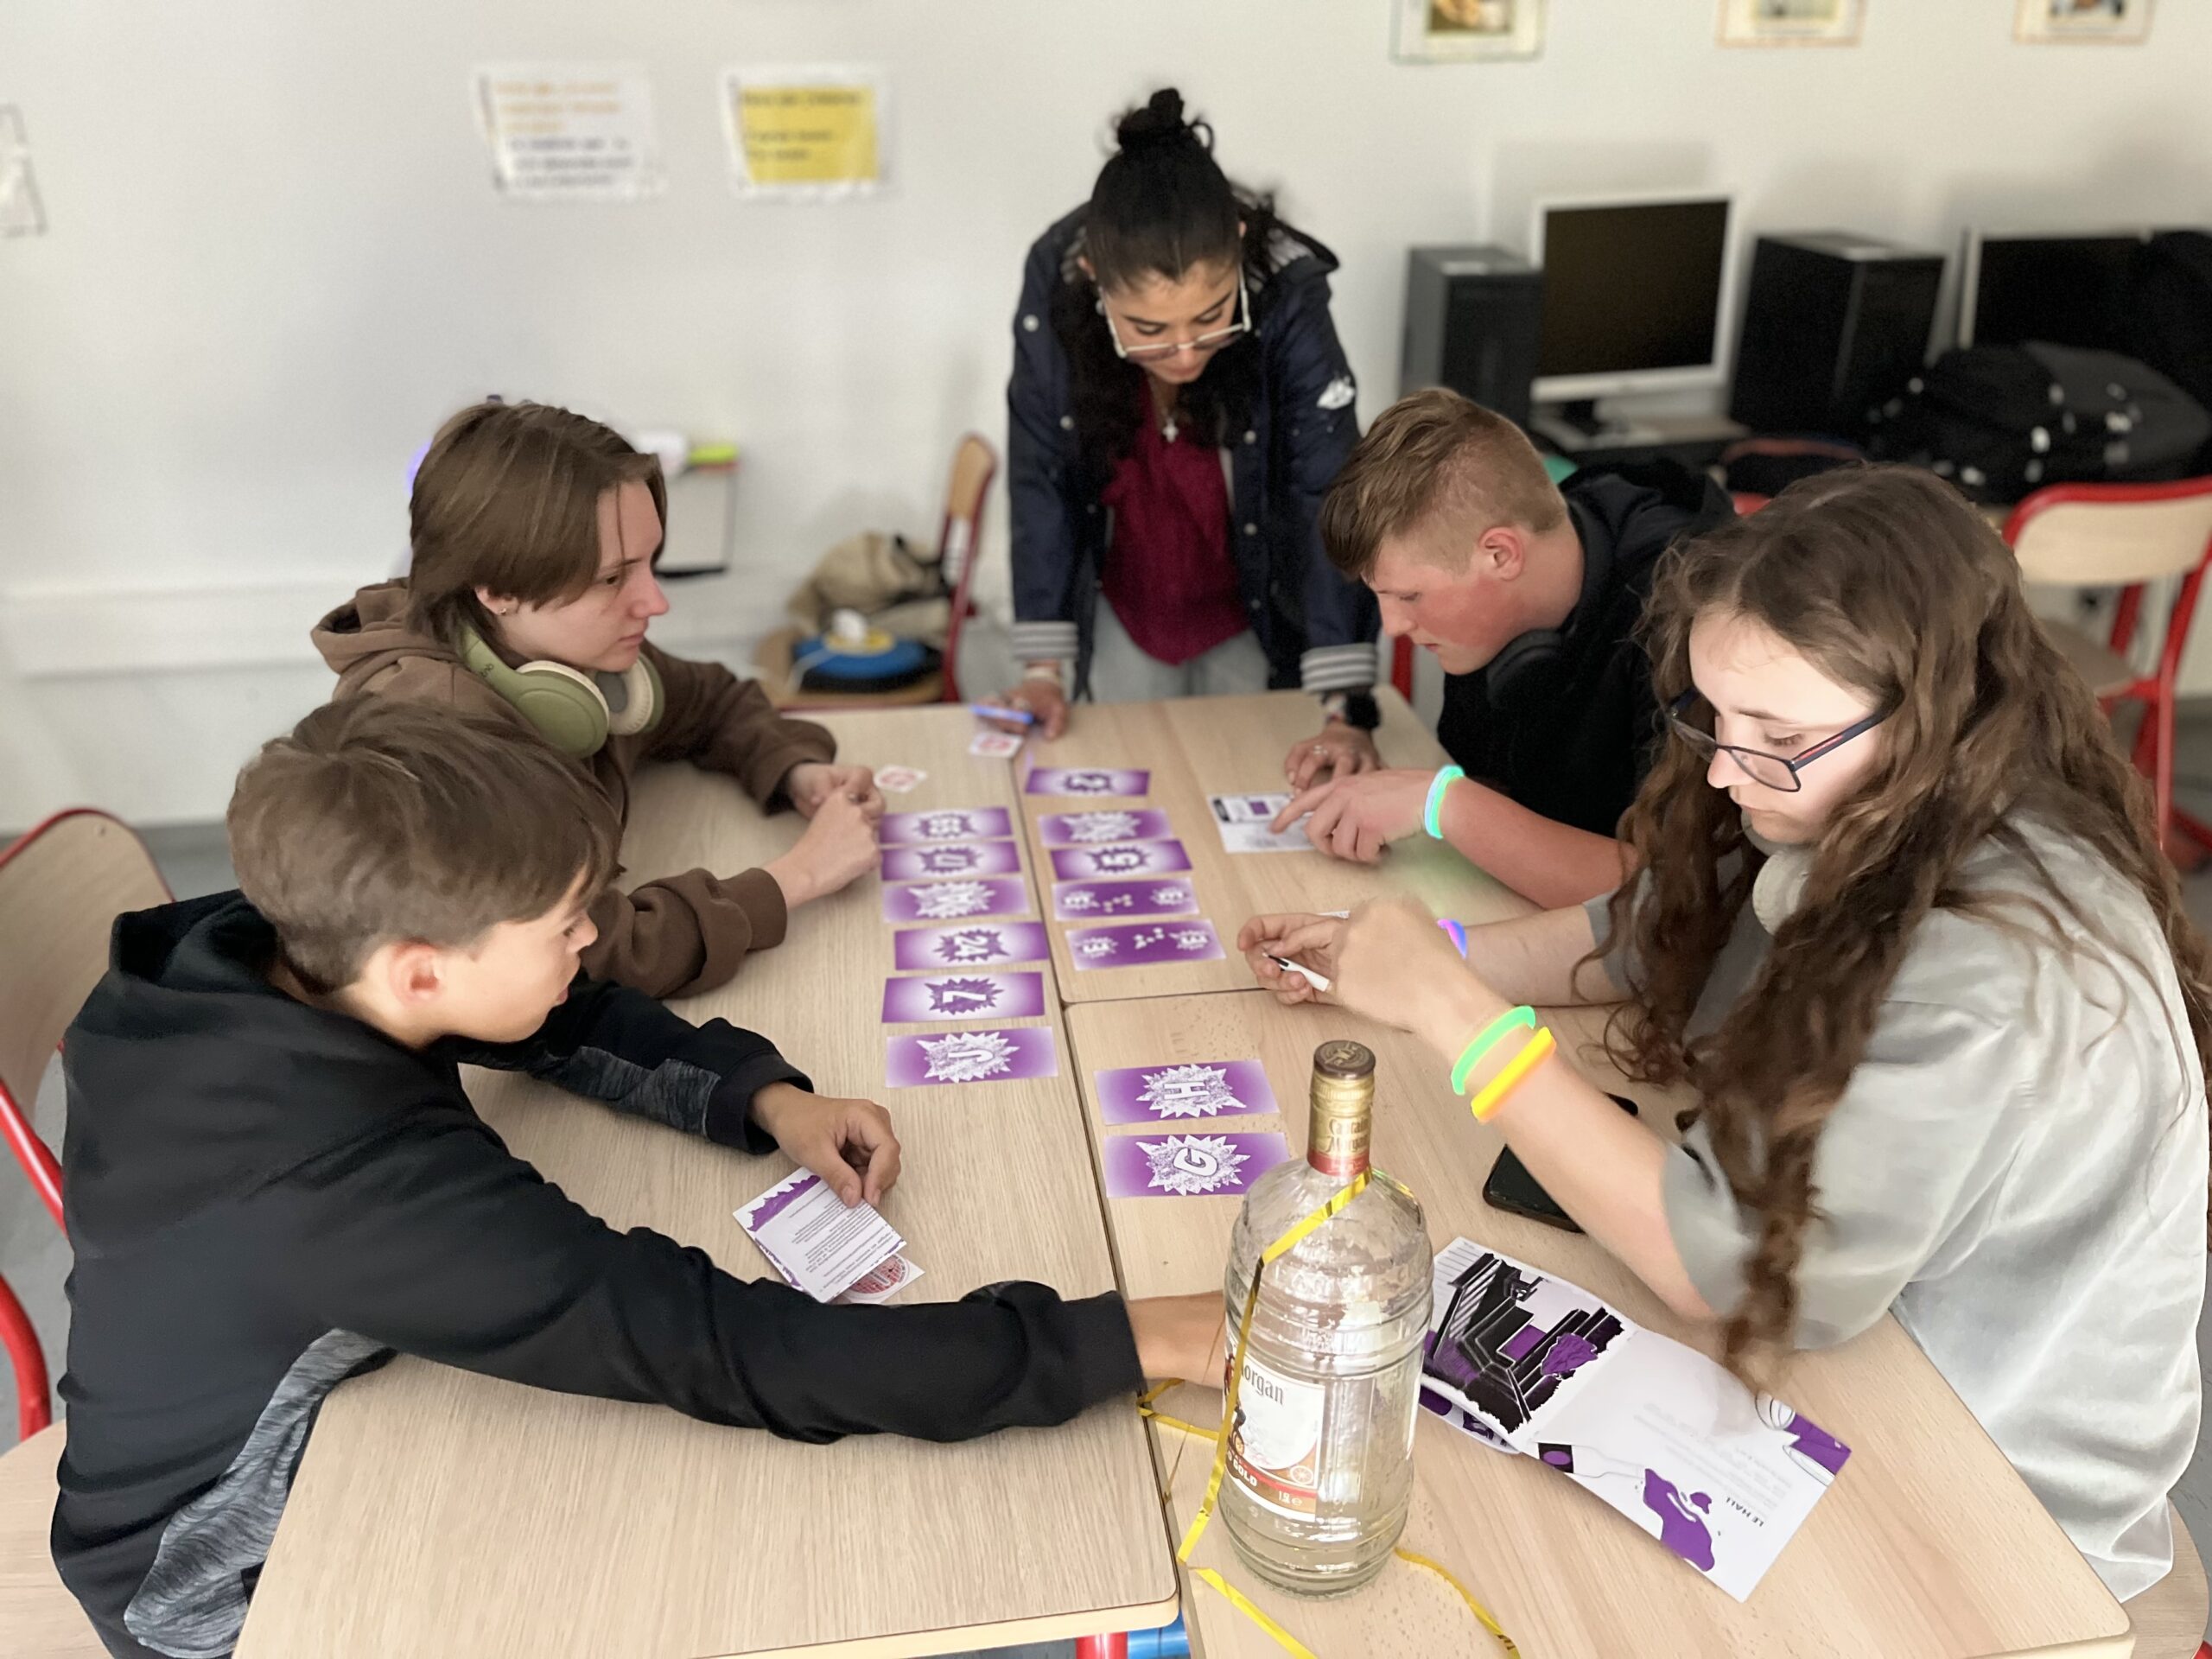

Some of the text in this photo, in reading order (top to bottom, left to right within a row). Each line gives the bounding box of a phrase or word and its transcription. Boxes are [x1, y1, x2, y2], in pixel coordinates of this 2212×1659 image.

[953, 935, 988, 957] 24
[942, 990, 987, 1003] 7
[948, 1049, 994, 1063] J
[1163, 1082, 1211, 1100] H
[1173, 1147, 1218, 1178] G
[1242, 1363, 1284, 1406] organ
[1233, 1458, 1257, 1487] GOLD
